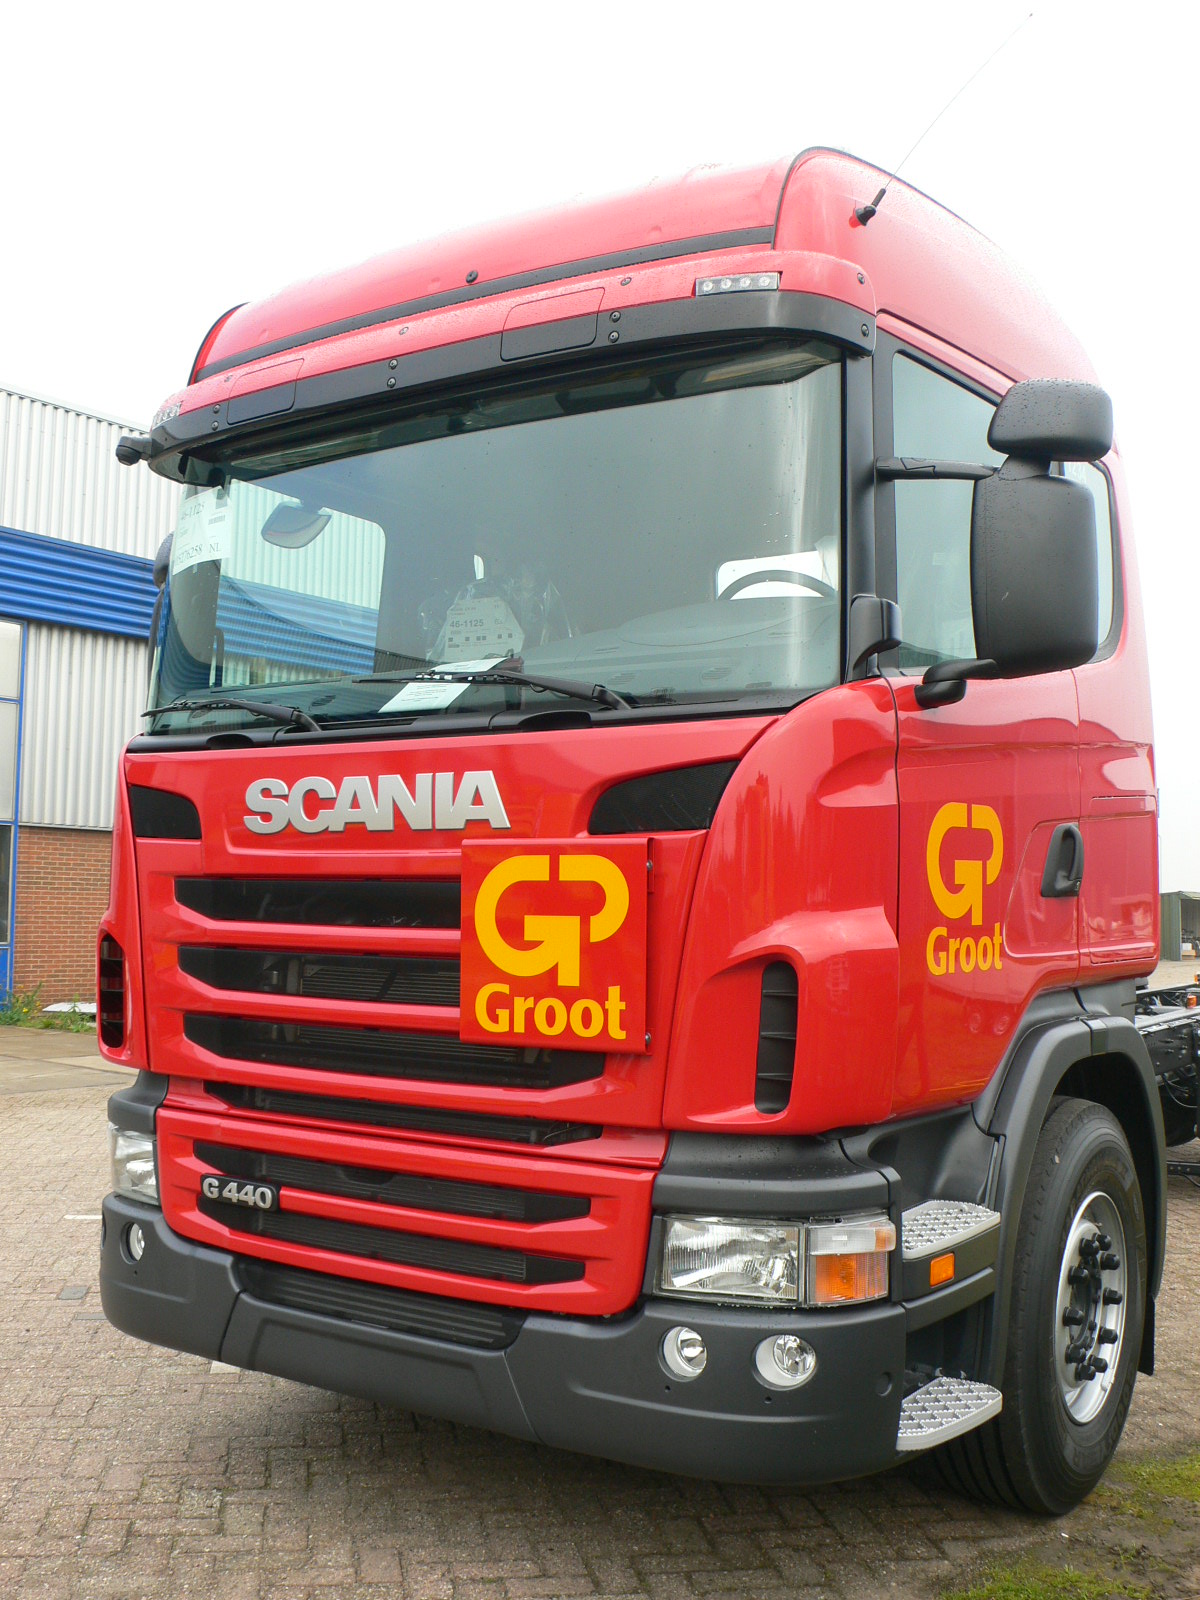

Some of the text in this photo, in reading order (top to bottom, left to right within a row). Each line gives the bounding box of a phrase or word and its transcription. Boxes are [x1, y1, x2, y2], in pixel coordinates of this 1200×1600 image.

[449, 618, 484, 628] 46-1125
[243, 770, 511, 834] SCANIA
[926, 922, 1003, 976] Groot
[475, 983, 627, 1039] Groot
[202, 1177, 273, 1209] G 440
